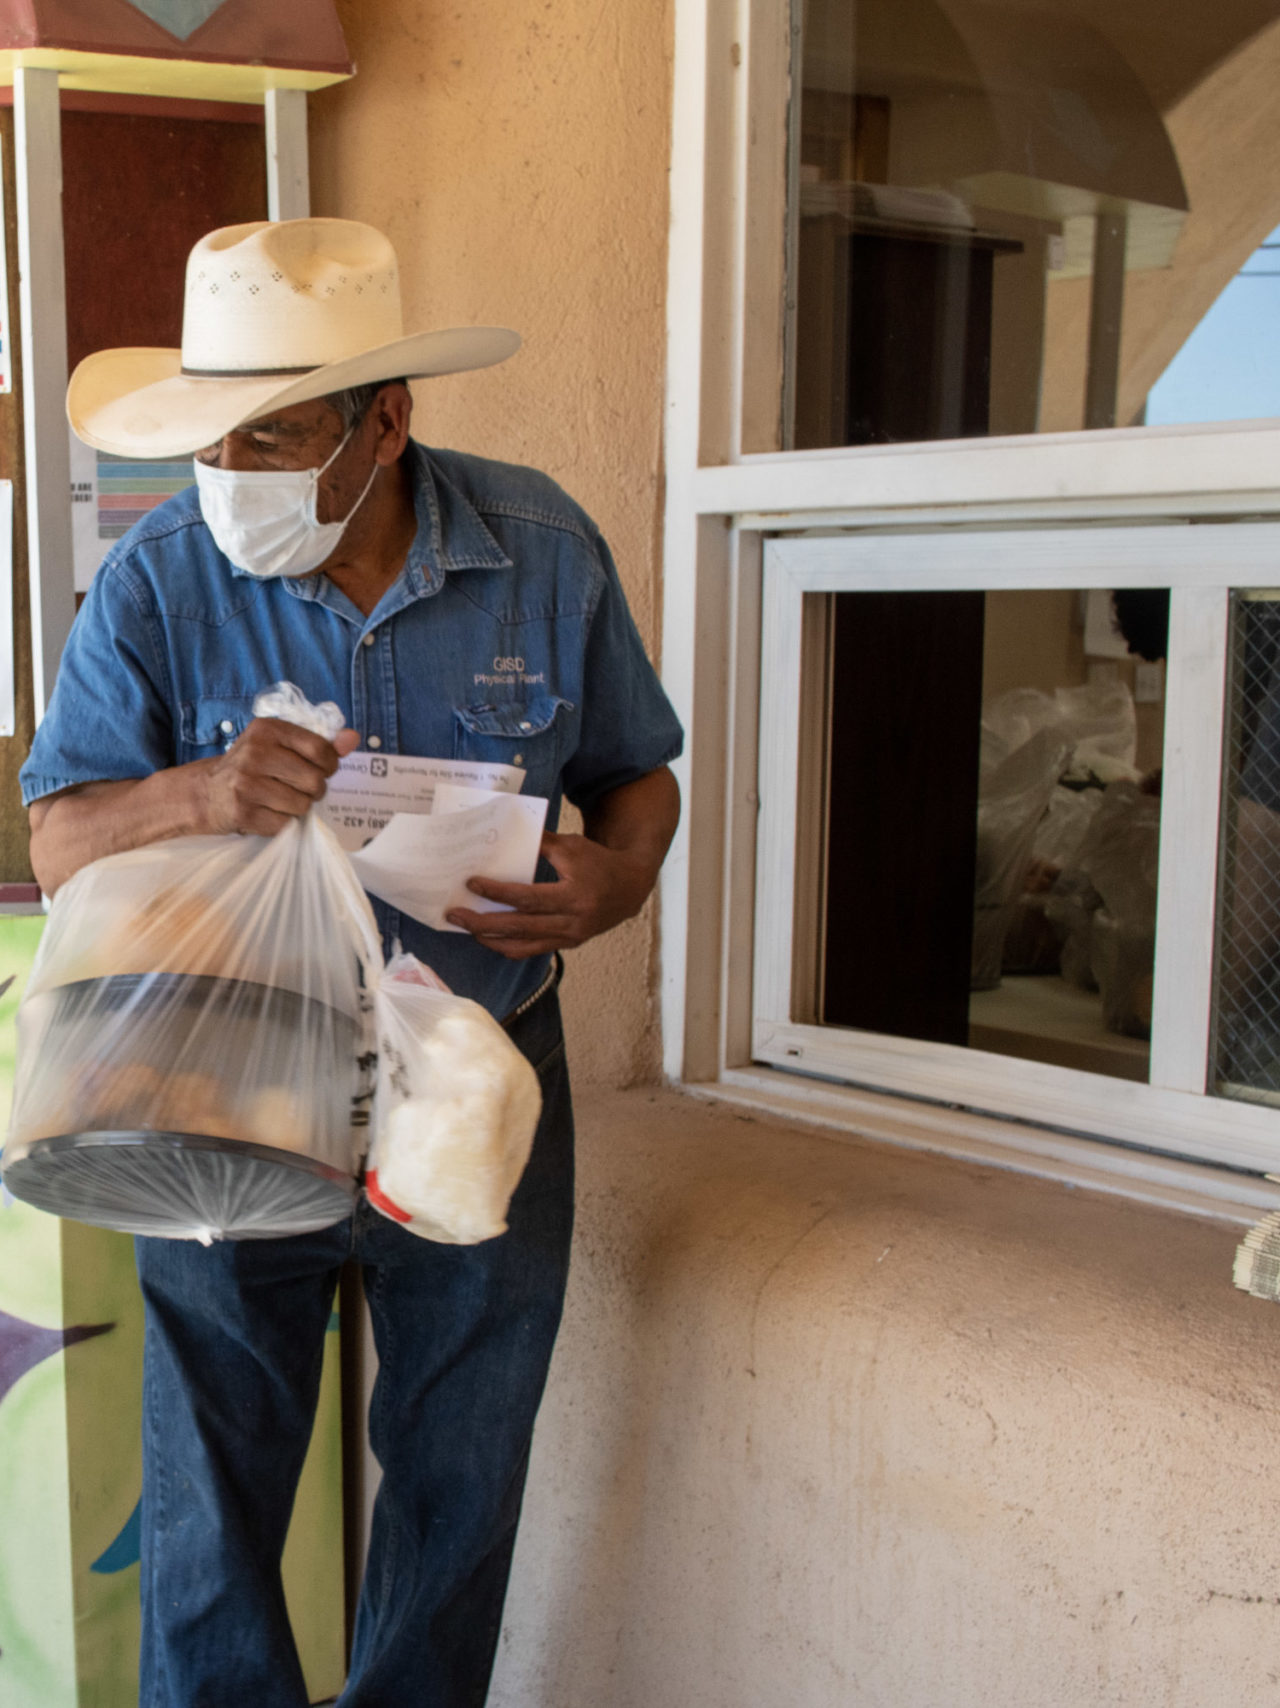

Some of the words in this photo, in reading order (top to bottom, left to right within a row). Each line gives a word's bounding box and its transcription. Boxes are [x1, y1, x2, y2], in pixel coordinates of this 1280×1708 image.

[493, 656, 525, 672] GISD
[474, 673, 516, 686] Physical
[519, 672, 546, 684] Plant
[344, 816, 364, 828] 432
